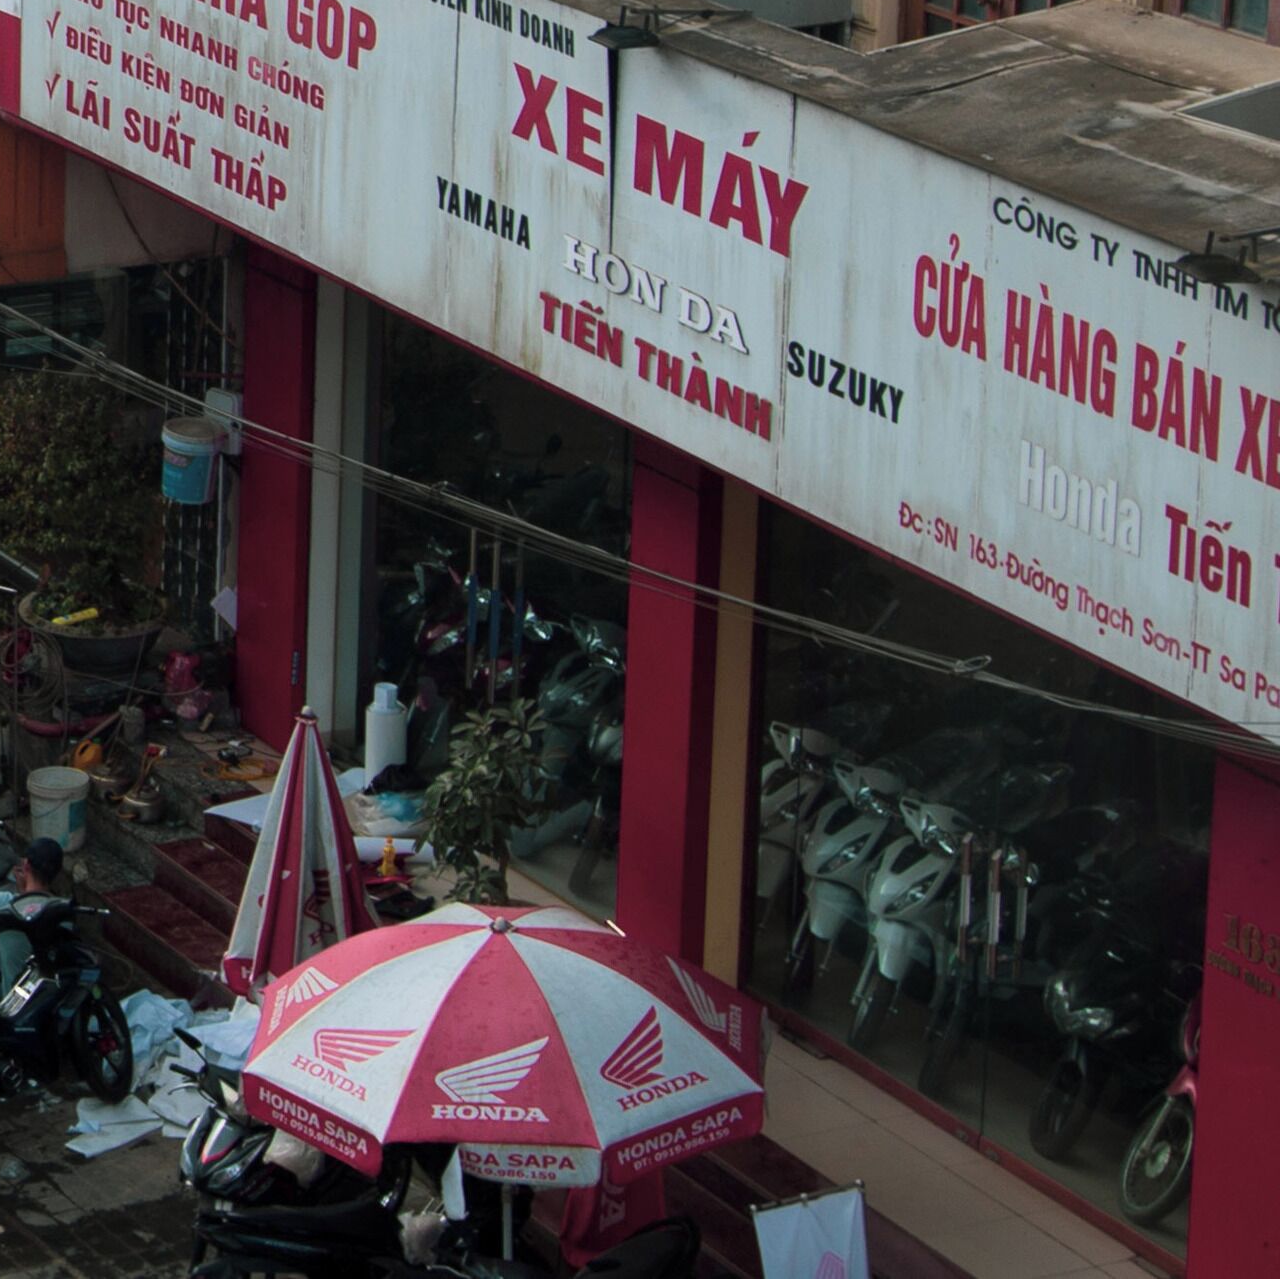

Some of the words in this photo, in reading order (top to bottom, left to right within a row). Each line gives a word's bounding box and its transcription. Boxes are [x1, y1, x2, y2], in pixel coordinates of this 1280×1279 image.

[159, 16, 239, 72] NHANH
[247, 57, 326, 112] CHÓNG
[519, 8, 576, 59] DOANH
[65, 25, 113, 67] ĐIỀU
[120, 51, 172, 94] KIỆN
[179, 78, 225, 119] ĐƠN
[234, 104, 290, 150] GIẢN
[65, 78, 111, 131] LÃI
[123, 108, 196, 170] SUẤT
[210, 147, 288, 212] THẤP
[511, 61, 606, 177] XE
[632, 113, 810, 258] MÁY
[436, 175, 532, 251] YAMAHA
[992, 195, 1079, 252] CÔNG
[1090, 232, 1121, 268] TY
[1133, 250, 1199, 303] TNHH
[634, 337, 773, 443] THÀNH
[787, 340, 905, 424] SUZUKY
[913, 233, 988, 363] CỬA
[1003, 282, 1118, 420] HÀNG
[1131, 340, 1223, 463] BÁN
[1018, 439, 1142, 558] Honda
[1165, 504, 1251, 608] Tiến
[1077, 584, 1133, 637] Thạch
[1220, 656, 1246, 690] Sa
[259, 1086, 320, 1129] HONDA
[325, 1120, 368, 1156] SAPA
[291, 1054, 368, 1102] HONDA
[432, 1103, 550, 1123] HONDA
[616, 1071, 709, 1112] HONDA
[507, 1153, 576, 1171] SAPA
[617, 1130, 686, 1165] HONDA
[691, 1106, 743, 1136] SAPA
